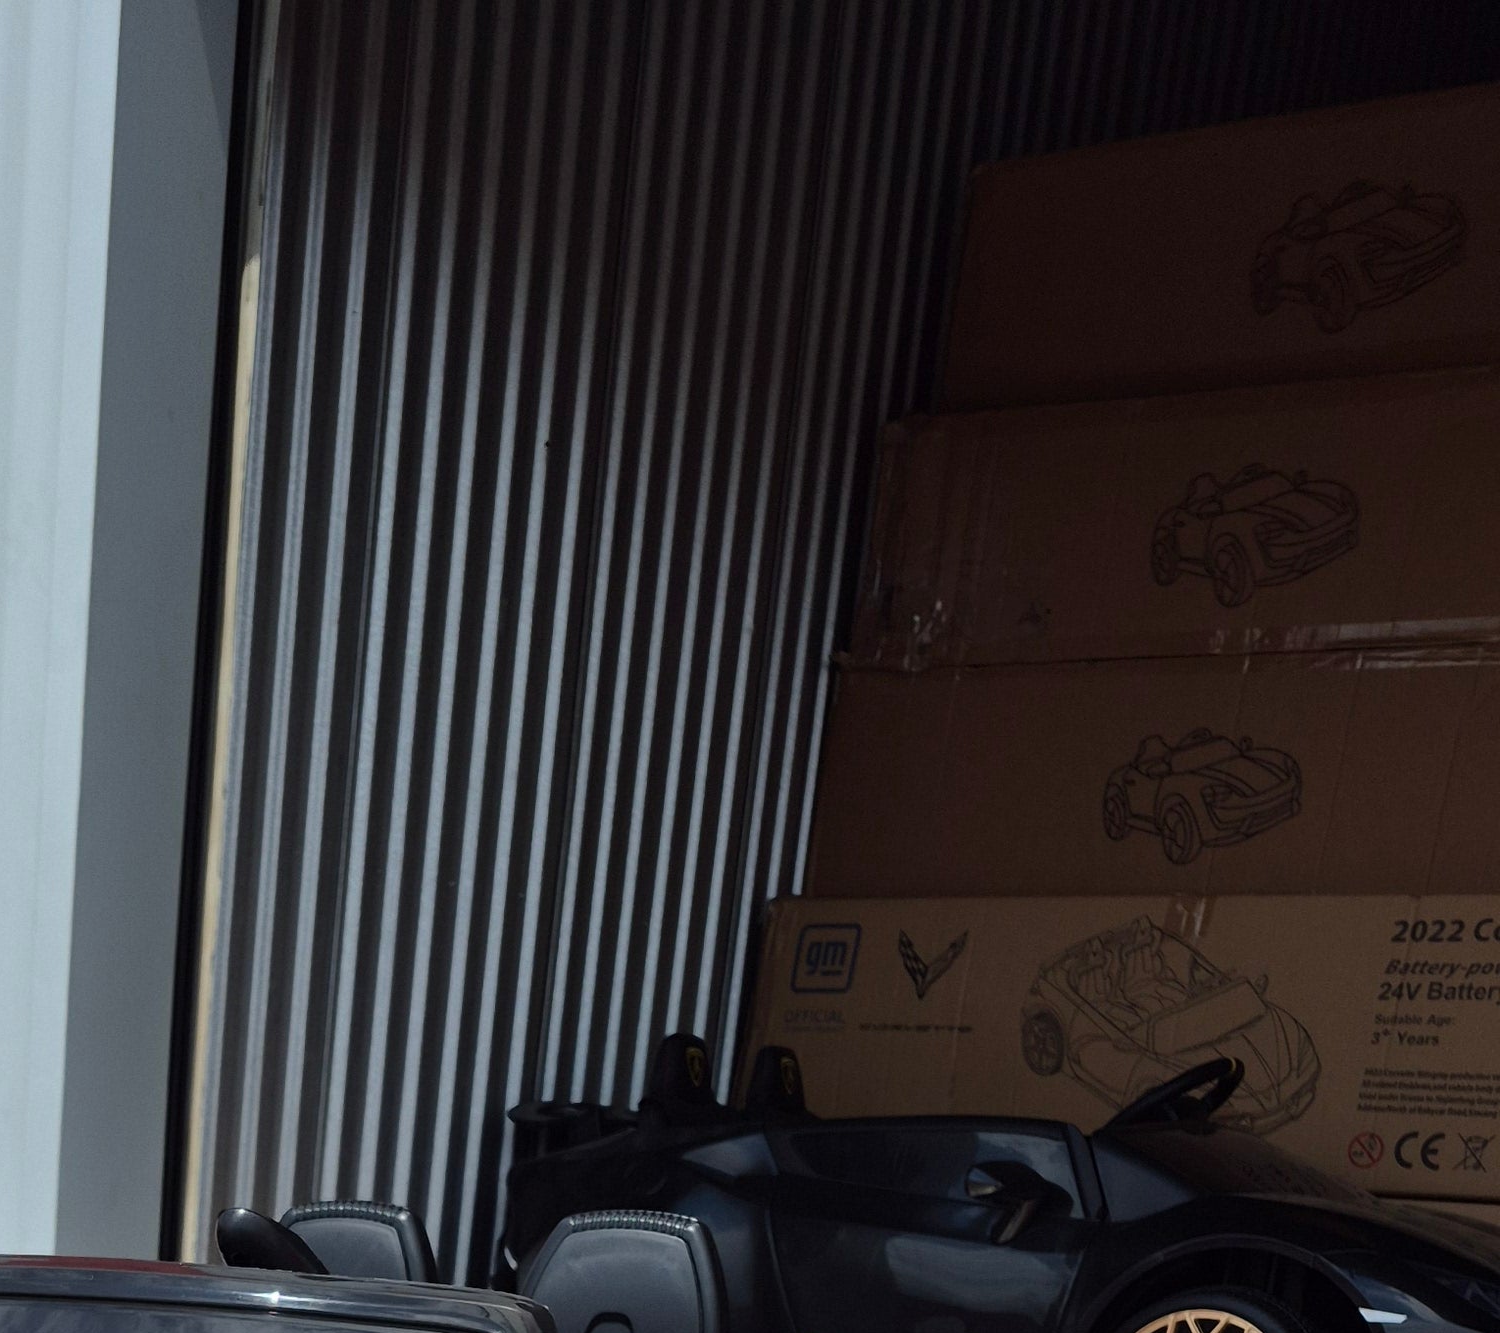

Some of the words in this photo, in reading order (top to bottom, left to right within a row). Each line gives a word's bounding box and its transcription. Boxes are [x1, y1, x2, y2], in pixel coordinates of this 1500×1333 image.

[1391, 919, 1465, 943] 2022
[805, 939, 848, 976] gm
[1378, 983, 1422, 1001] 24V
[784, 1010, 844, 1023] OFFICIAL
[1397, 1032, 1439, 1046] Years
